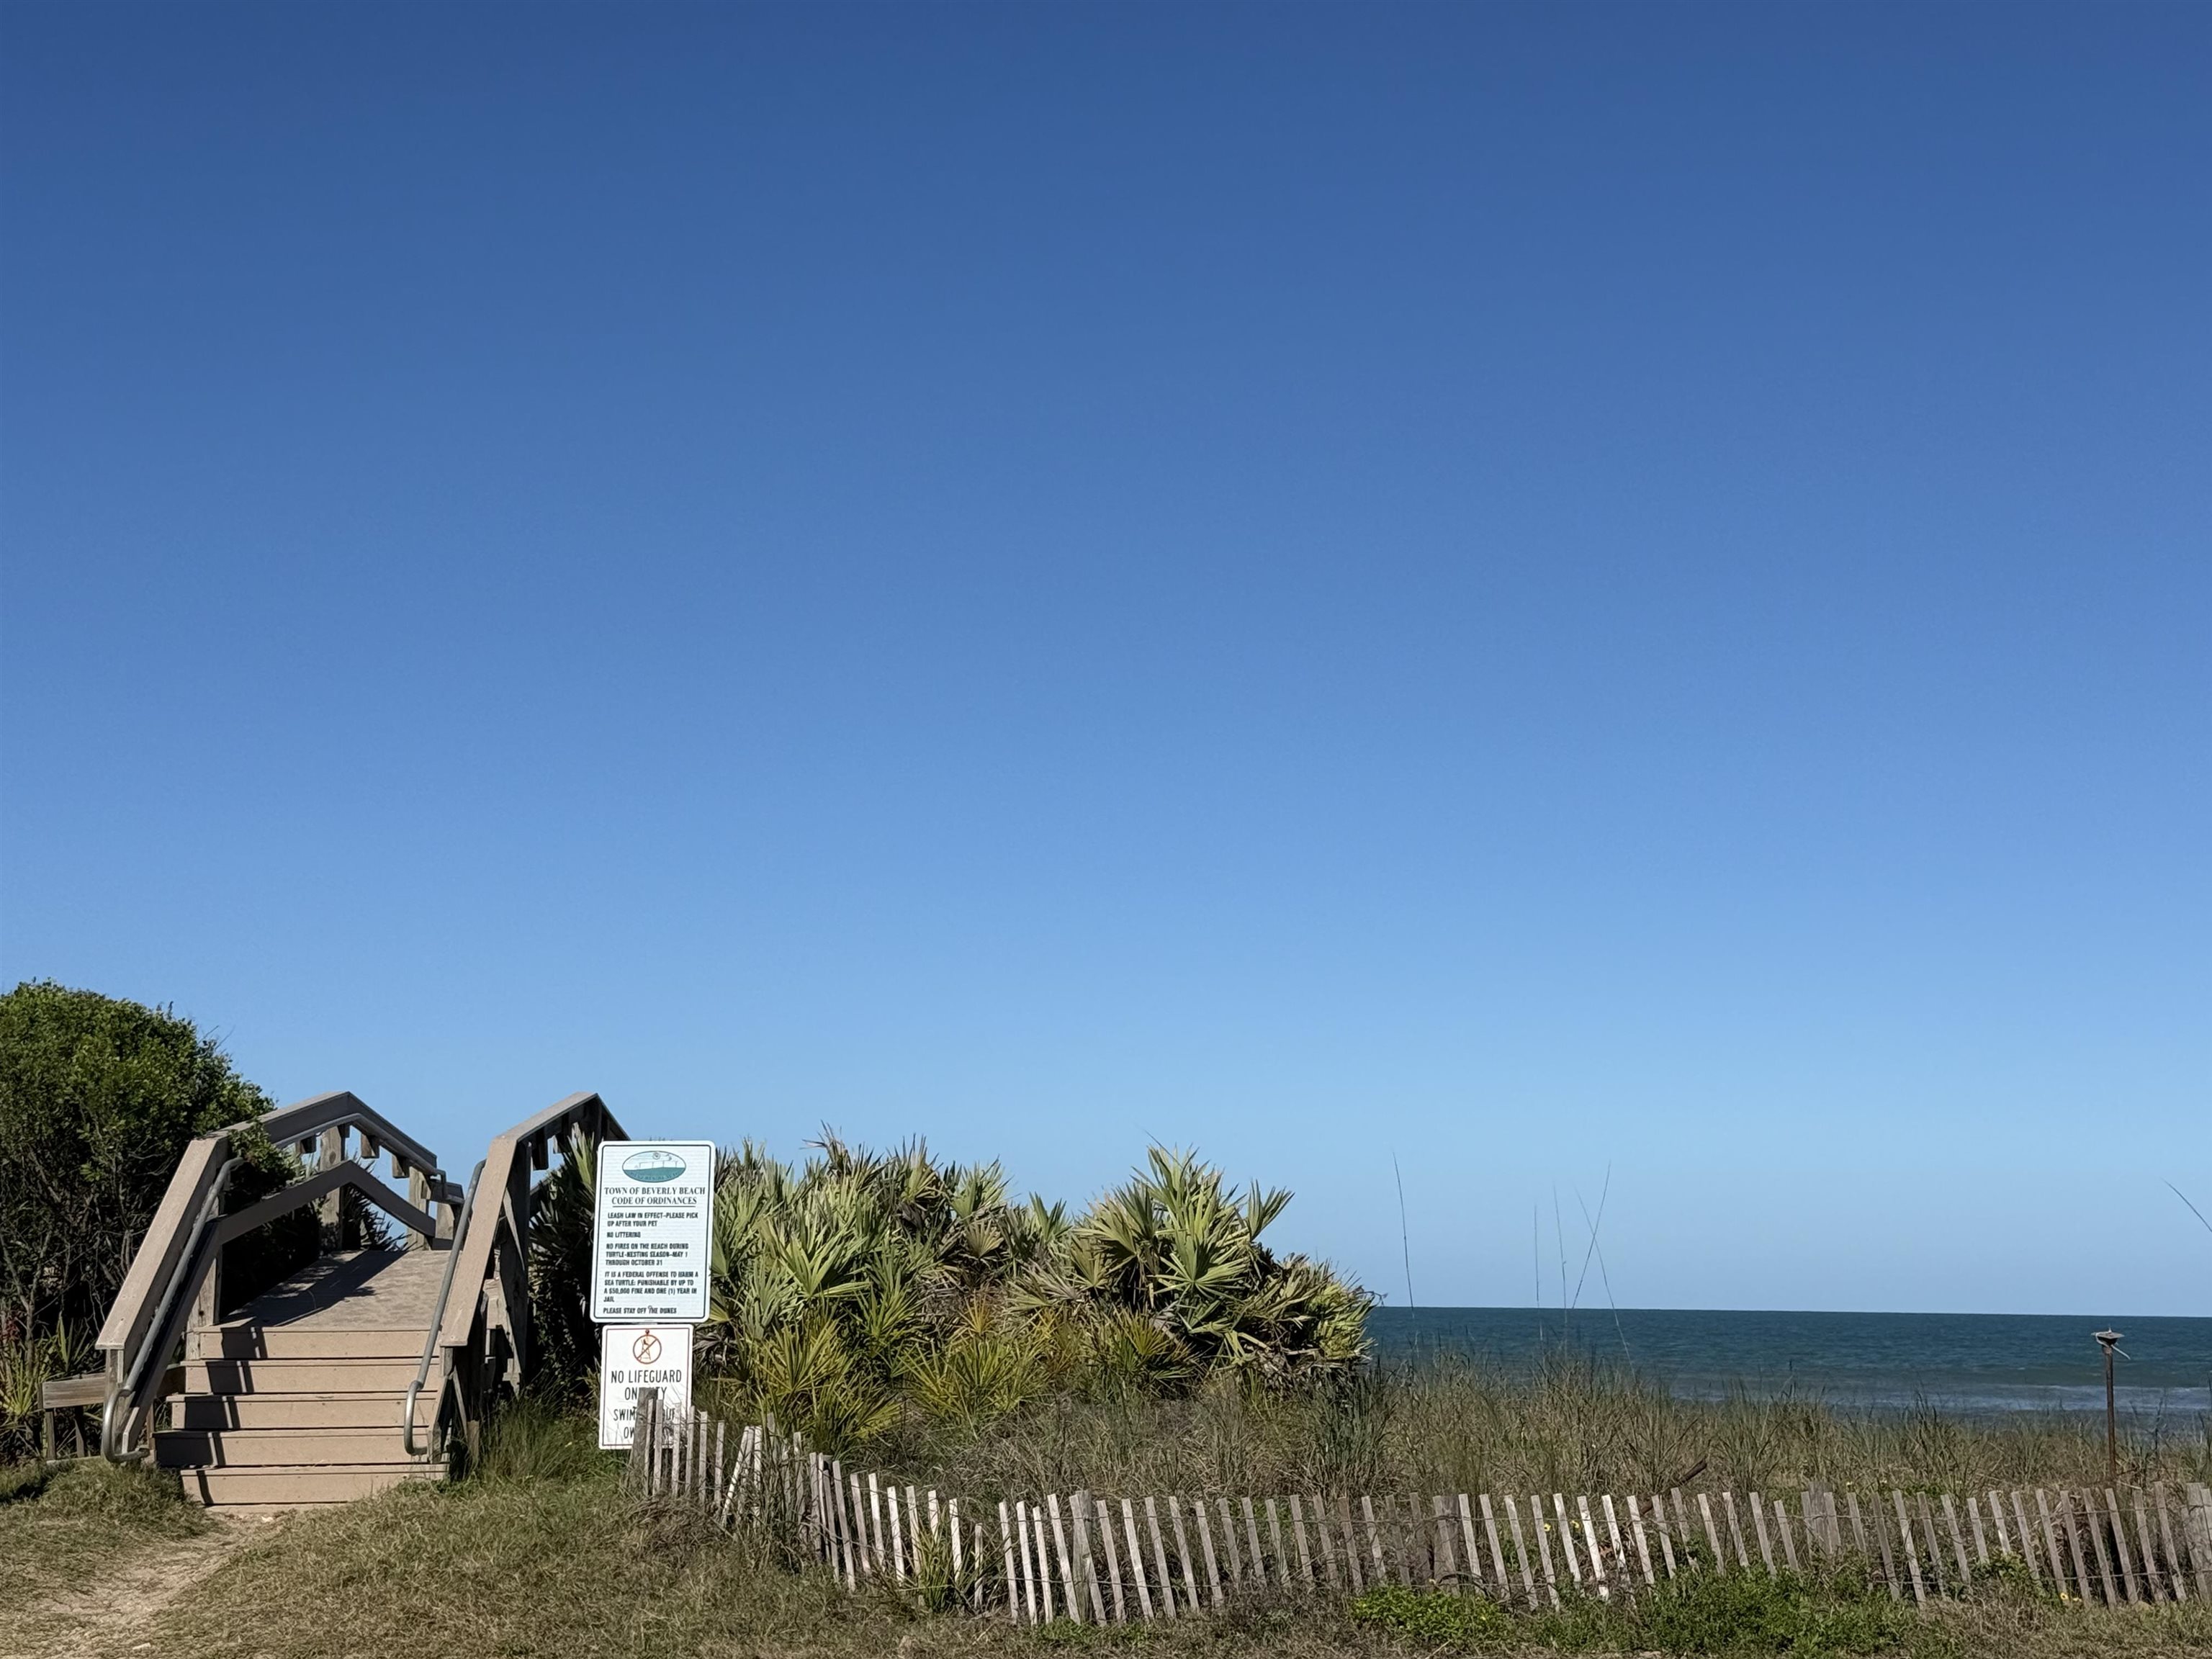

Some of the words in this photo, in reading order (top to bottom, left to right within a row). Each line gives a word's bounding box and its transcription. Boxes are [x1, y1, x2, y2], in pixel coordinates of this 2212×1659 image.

[611, 1370, 624, 1383] NO
[629, 1370, 681, 1382] LIFEGUARD
[625, 1387, 637, 1400] ON
[613, 1408, 636, 1421] SWIM
